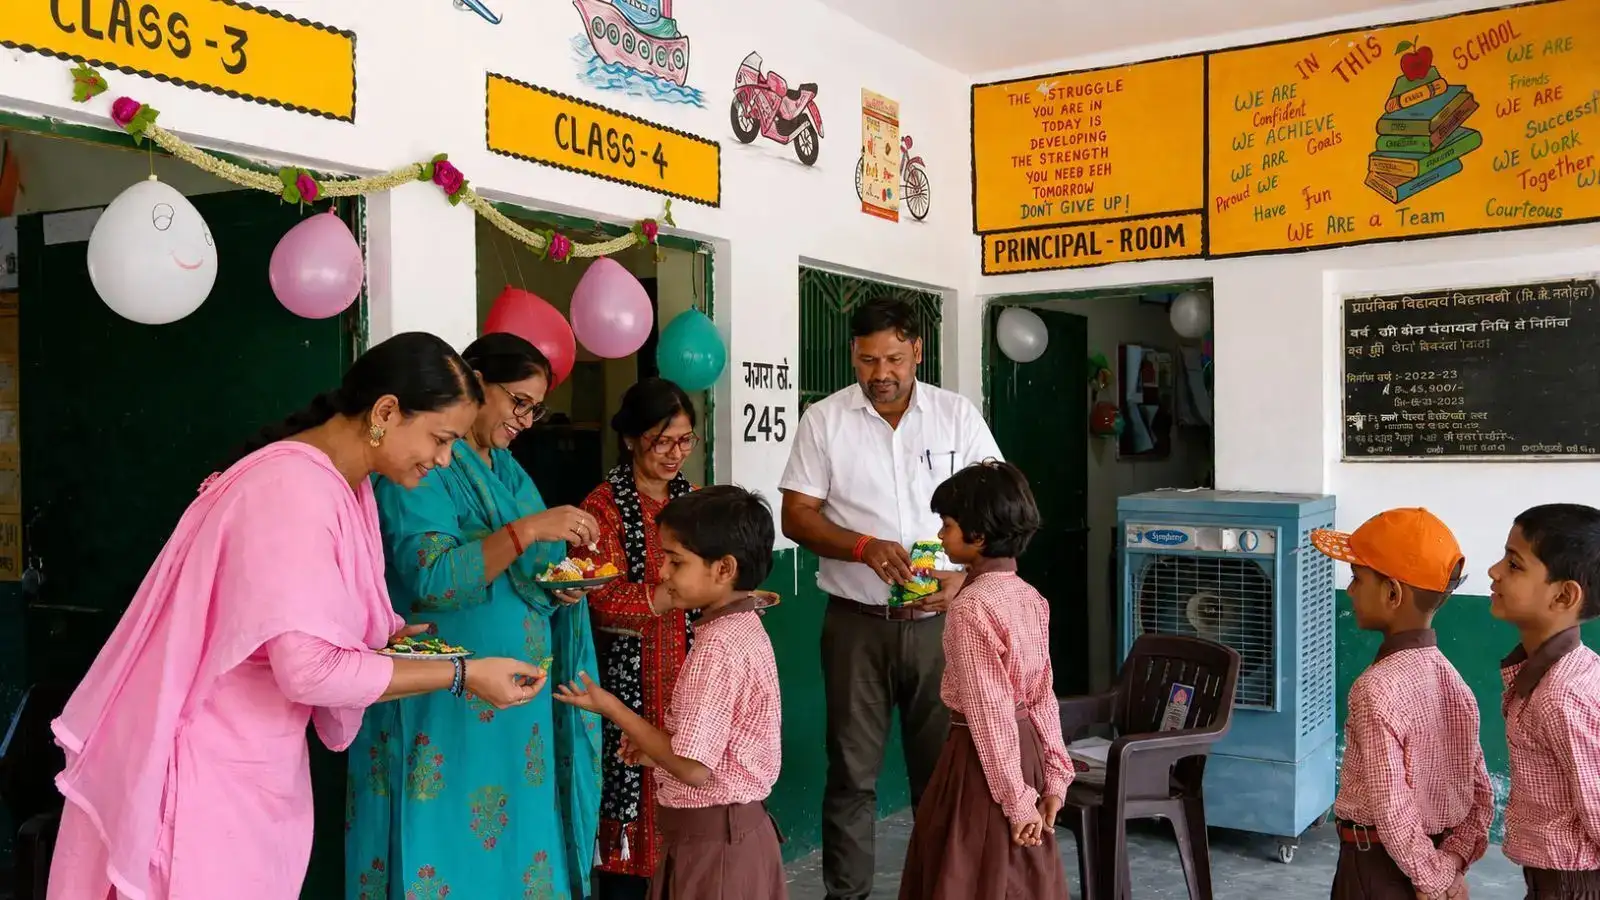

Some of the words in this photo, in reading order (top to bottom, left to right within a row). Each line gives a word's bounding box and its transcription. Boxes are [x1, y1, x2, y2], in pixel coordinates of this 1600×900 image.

[50, 0, 191, 59] CLASS
[1294, 53, 1320, 80] IN
[1331, 36, 1382, 83] THIS
[1453, 20, 1521, 70] SCHOOL
[1507, 43, 1534, 64] WE
[1542, 36, 1574, 56] ARE
[1008, 93, 1031, 106] THE
[1048, 79, 1123, 100] STRUGGLE
[1510, 72, 1550, 91] Friends
[1033, 106, 1053, 117] YOU
[1061, 103, 1083, 115] ARE
[1235, 90, 1263, 112] WE
[1271, 83, 1298, 103] ARE
[1496, 98, 1521, 119] WE
[1533, 86, 1564, 107] ARE
[1042, 118, 1081, 133] TODAY
[1090, 115, 1101, 127] IS
[1253, 100, 1307, 128] Confident
[1030, 130, 1107, 150] DEVELOPING
[1232, 133, 1255, 151] WE
[1266, 113, 1335, 146] ACHIEVE
[1307, 131, 1342, 156] Goals
[1012, 154, 1032, 168] THE
[1040, 147, 1109, 165] STRENGTH
[1493, 150, 1520, 172] WE
[1026, 171, 1048, 184] YOU
[1231, 164, 1252, 183] WE
[1517, 155, 1595, 192] Together
[1033, 181, 1094, 200] TOMORROW
[1216, 184, 1250, 213] Proud
[1257, 175, 1278, 194] WE
[1253, 203, 1286, 222] Have
[1302, 185, 1332, 210] Fun
[1021, 200, 1053, 219] DON'T
[1060, 198, 1095, 213] GIVE
[1486, 197, 1563, 219] Courteous
[1287, 223, 1314, 242] WE
[1327, 215, 1355, 235] ARE
[1395, 207, 1445, 227] Team
[994, 231, 1102, 264] PRINCIPAL
[1120, 223, 1185, 252] ROOM
[744, 403, 787, 442] 245
